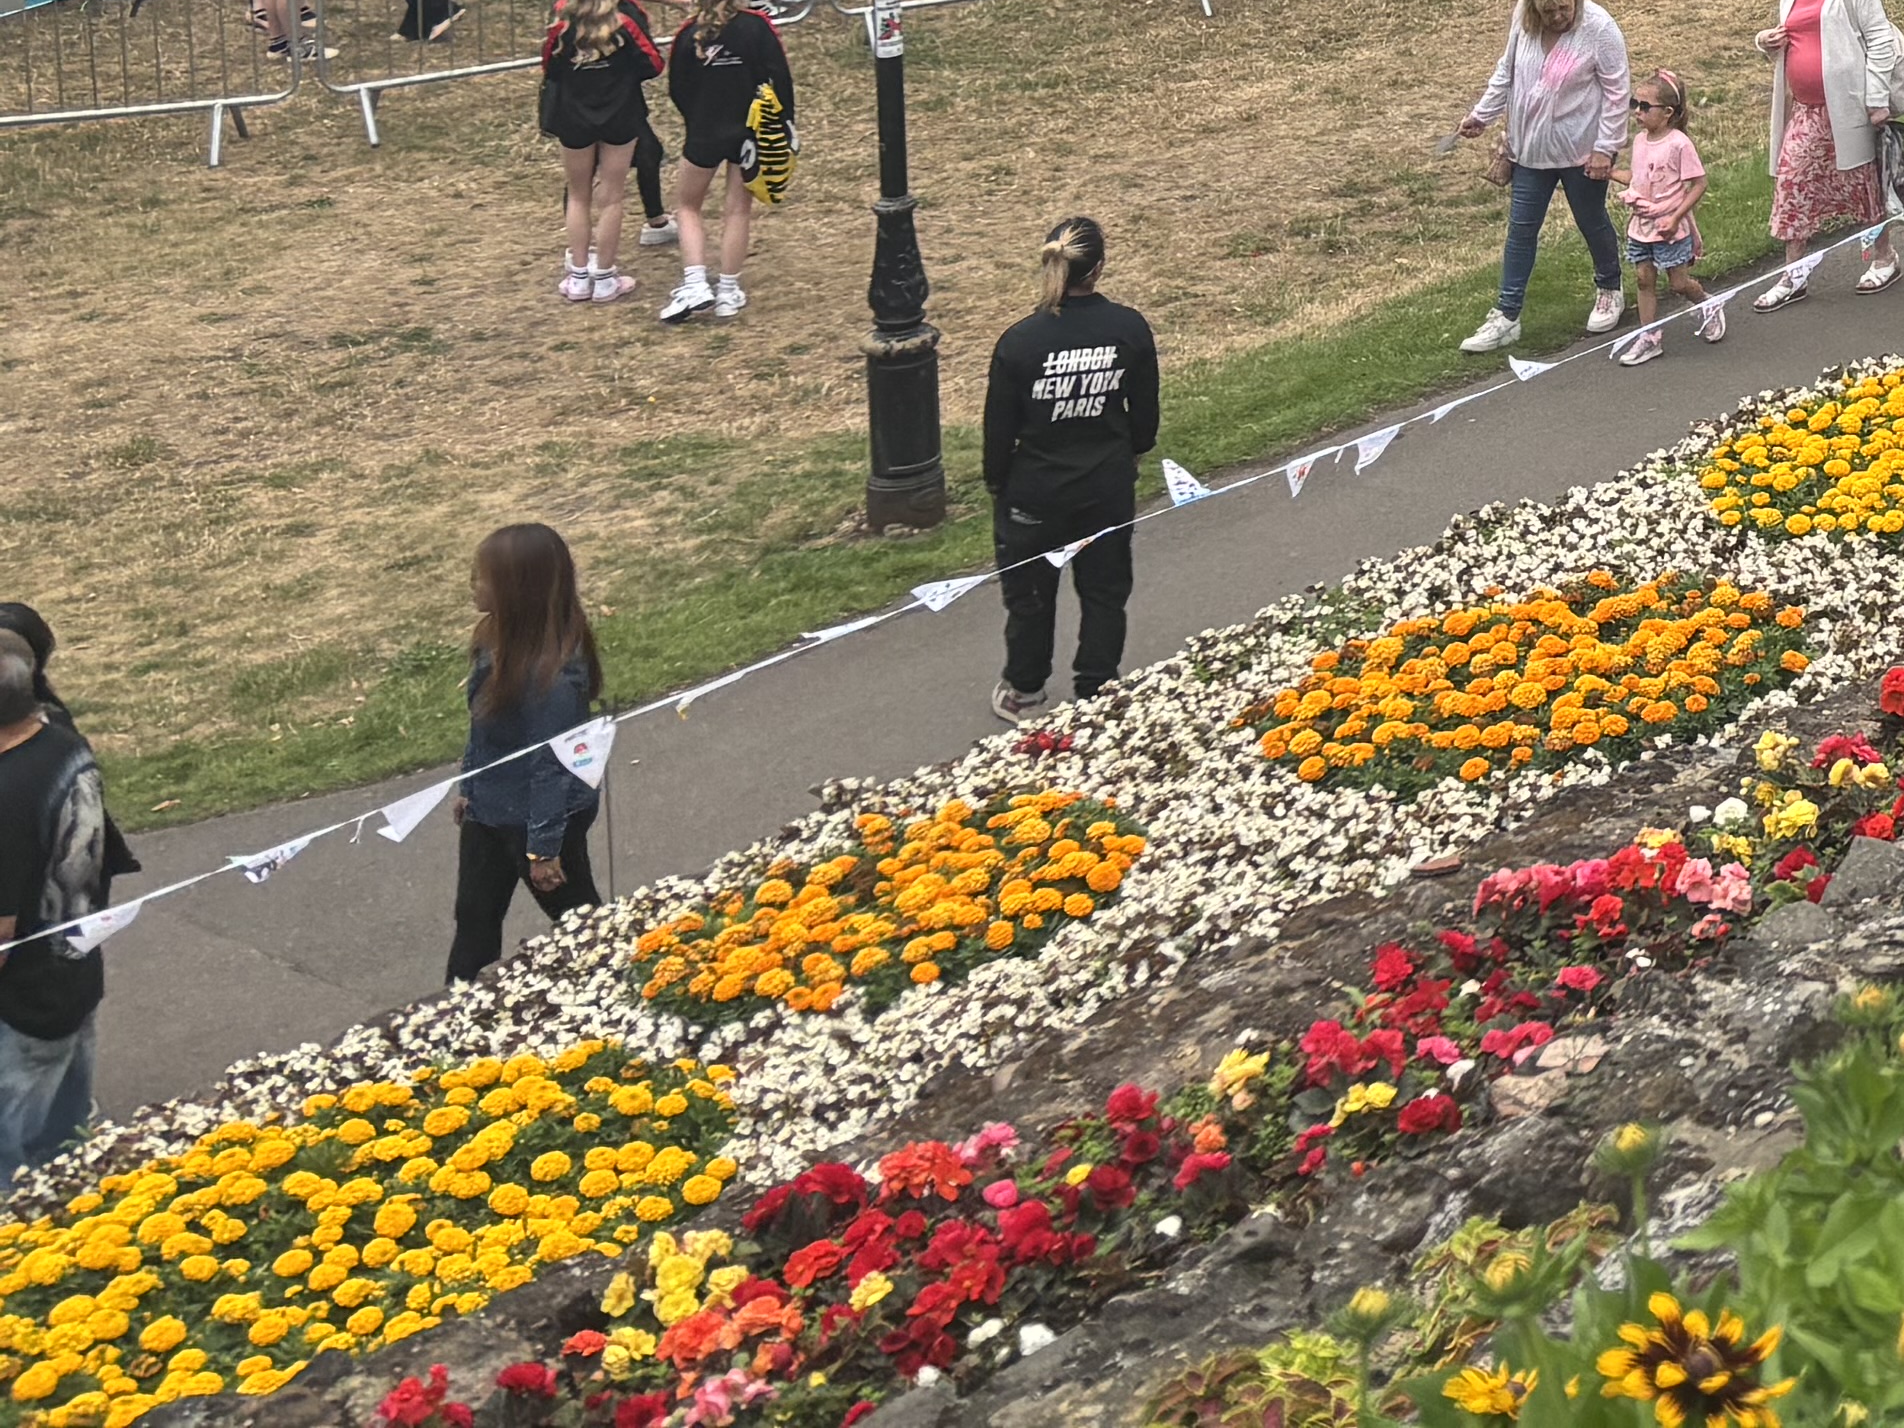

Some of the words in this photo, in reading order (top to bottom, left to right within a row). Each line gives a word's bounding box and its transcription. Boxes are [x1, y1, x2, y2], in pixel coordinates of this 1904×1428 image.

[1043, 346, 1118, 376] LONDON
[1031, 374, 1077, 400] NEW
[1079, 369, 1126, 395] YORK
[1051, 396, 1107, 423] PARIS
